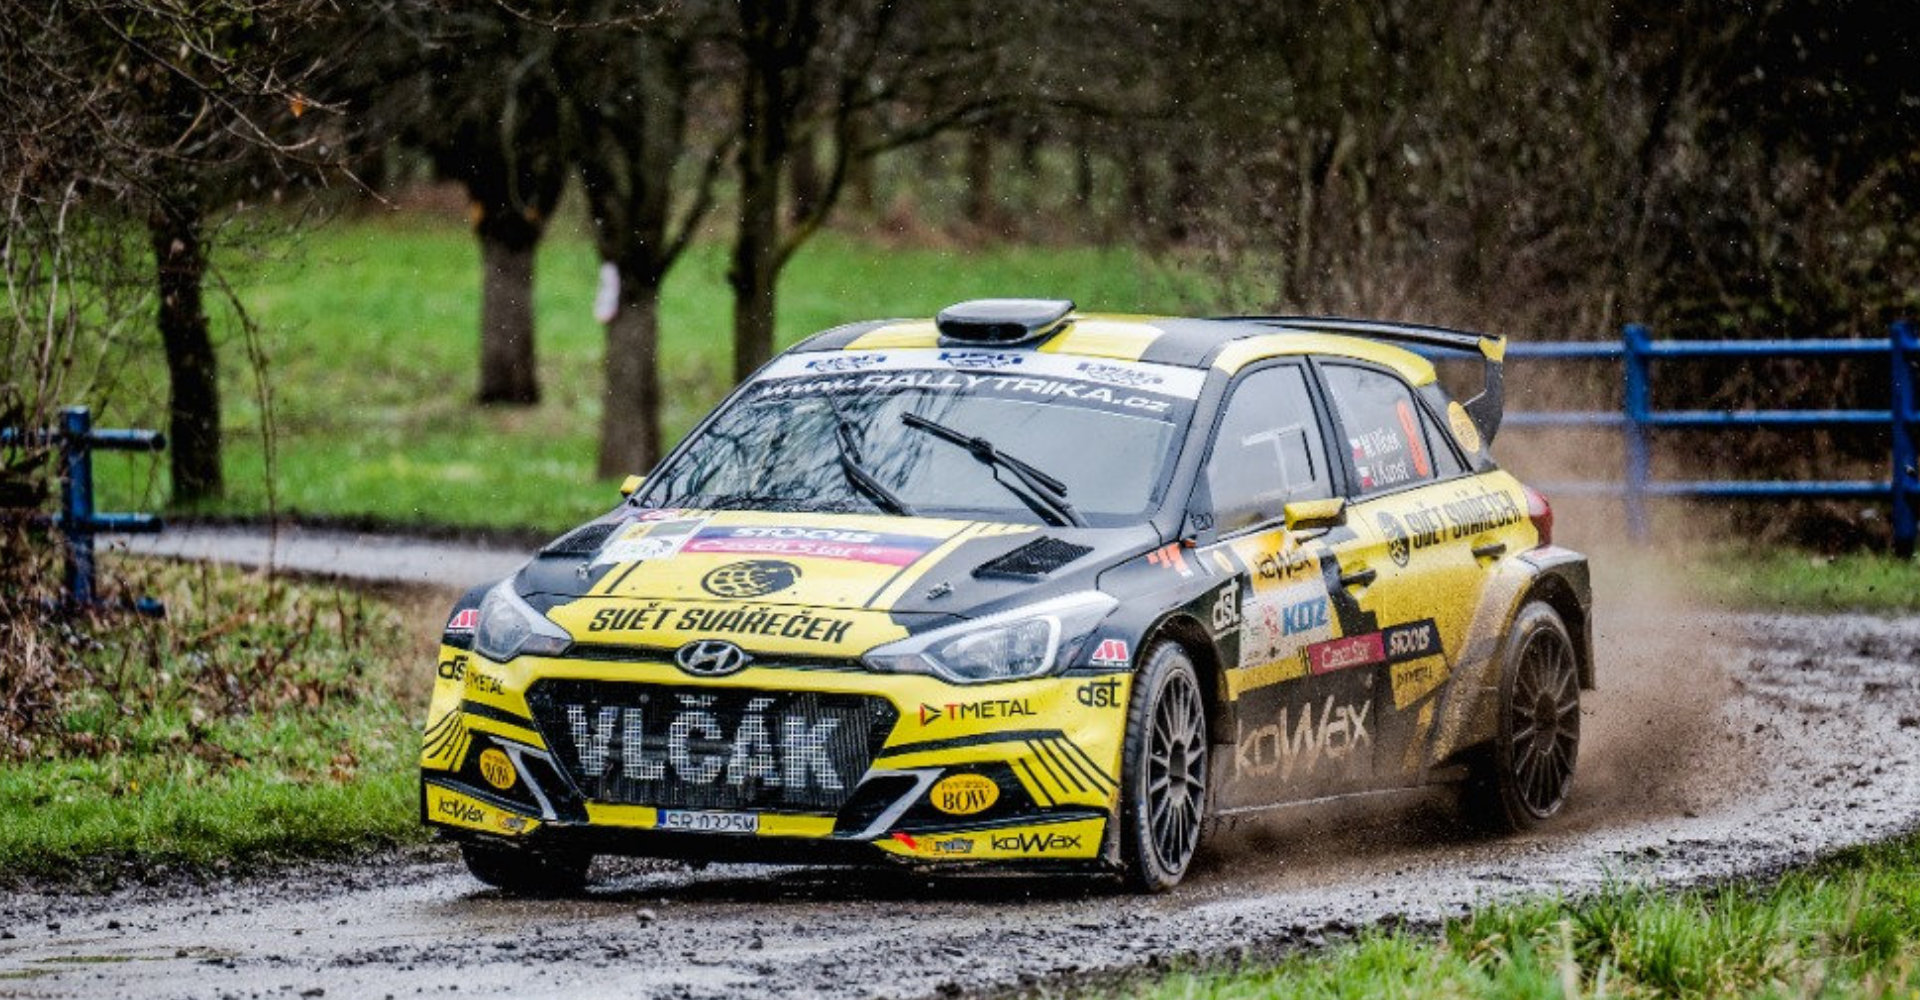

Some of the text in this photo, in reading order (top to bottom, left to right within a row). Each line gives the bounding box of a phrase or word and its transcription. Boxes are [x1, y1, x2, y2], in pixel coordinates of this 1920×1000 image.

[1077, 678, 1121, 707] dst
[945, 698, 1036, 720] TMETAL
[567, 694, 844, 789] VLČÁK
[943, 789, 990, 812] BOW
